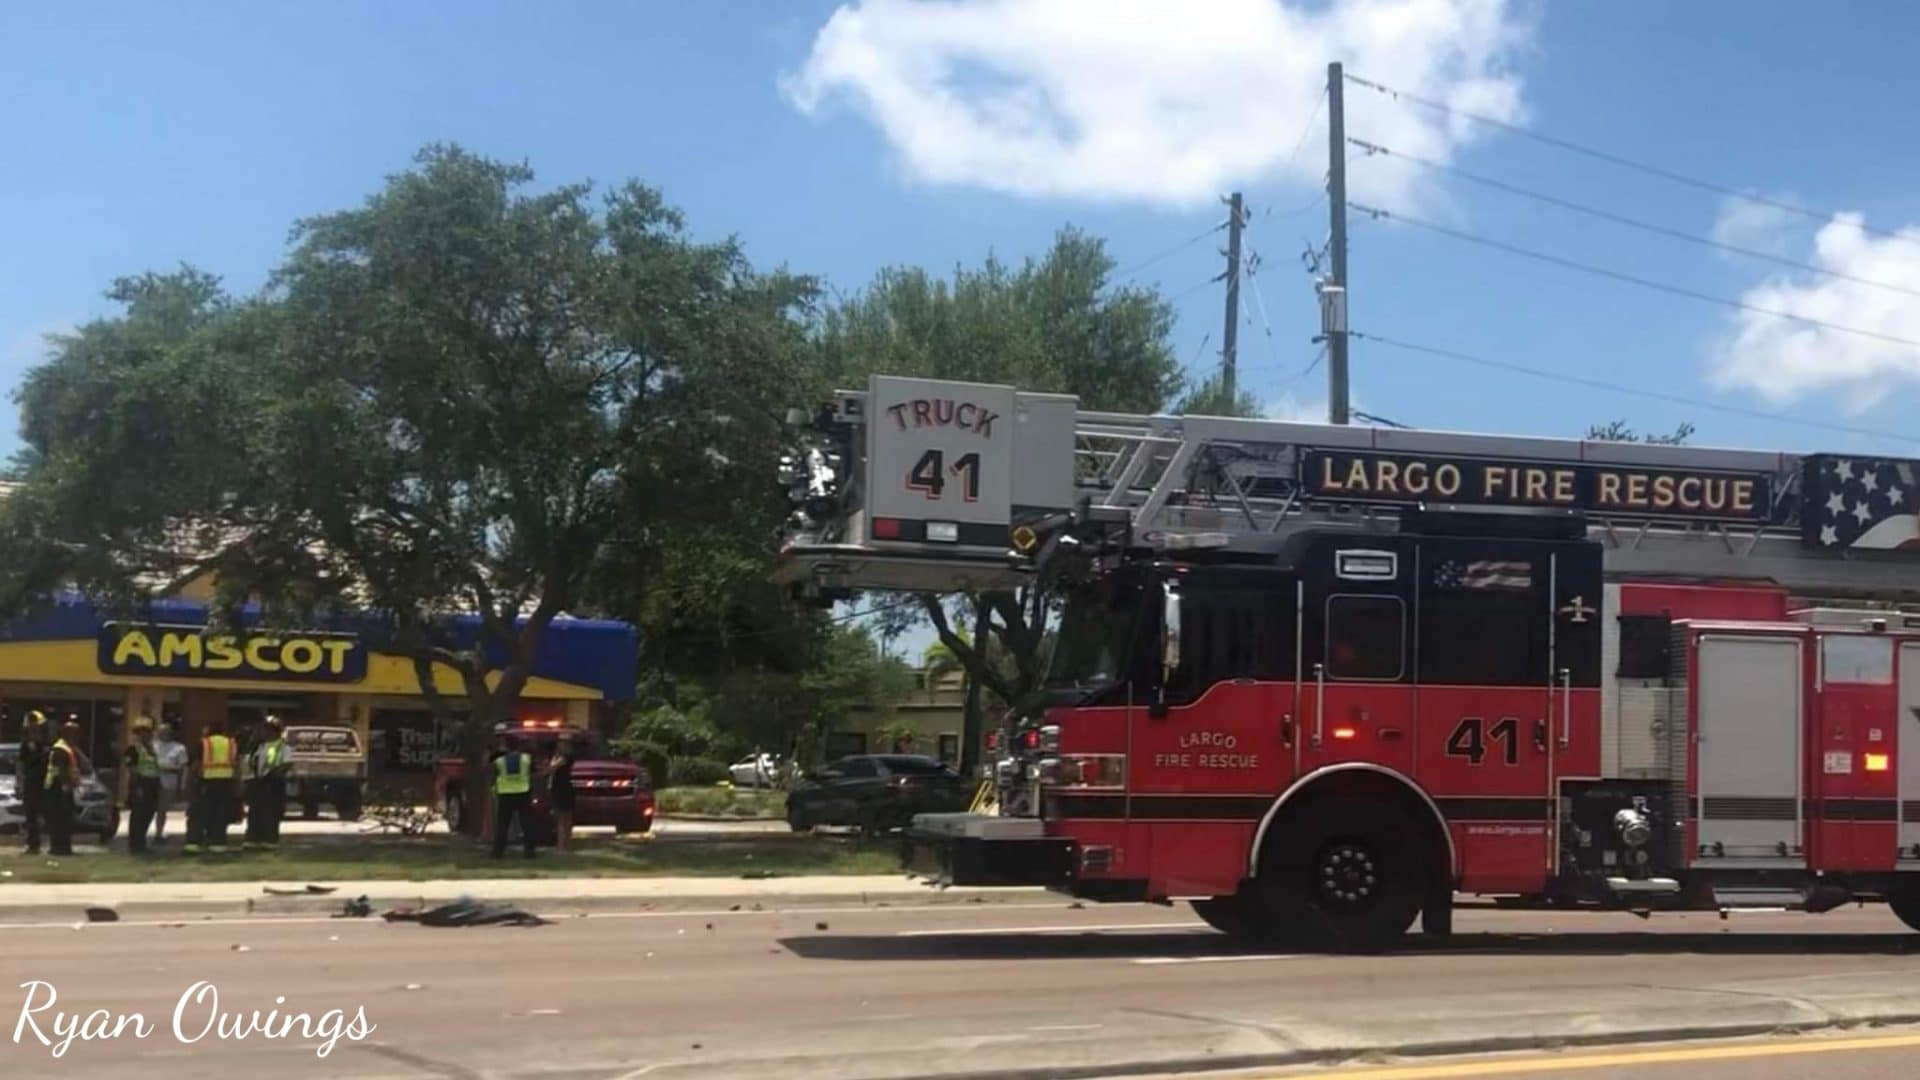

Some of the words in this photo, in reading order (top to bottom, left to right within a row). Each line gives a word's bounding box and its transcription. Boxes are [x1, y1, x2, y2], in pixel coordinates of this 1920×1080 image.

[886, 398, 999, 440] TRUCK
[905, 449, 980, 503] 41
[1322, 456, 1462, 495] LARGO
[1483, 466, 1576, 501] FIRE
[1599, 472, 1755, 511] RESCUE
[113, 631, 354, 674] AMSCOT
[1155, 753, 1192, 768] FIRE
[1199, 753, 1259, 769] RESCUE
[1179, 732, 1237, 749] LARGO
[1444, 716, 1520, 767] 41
